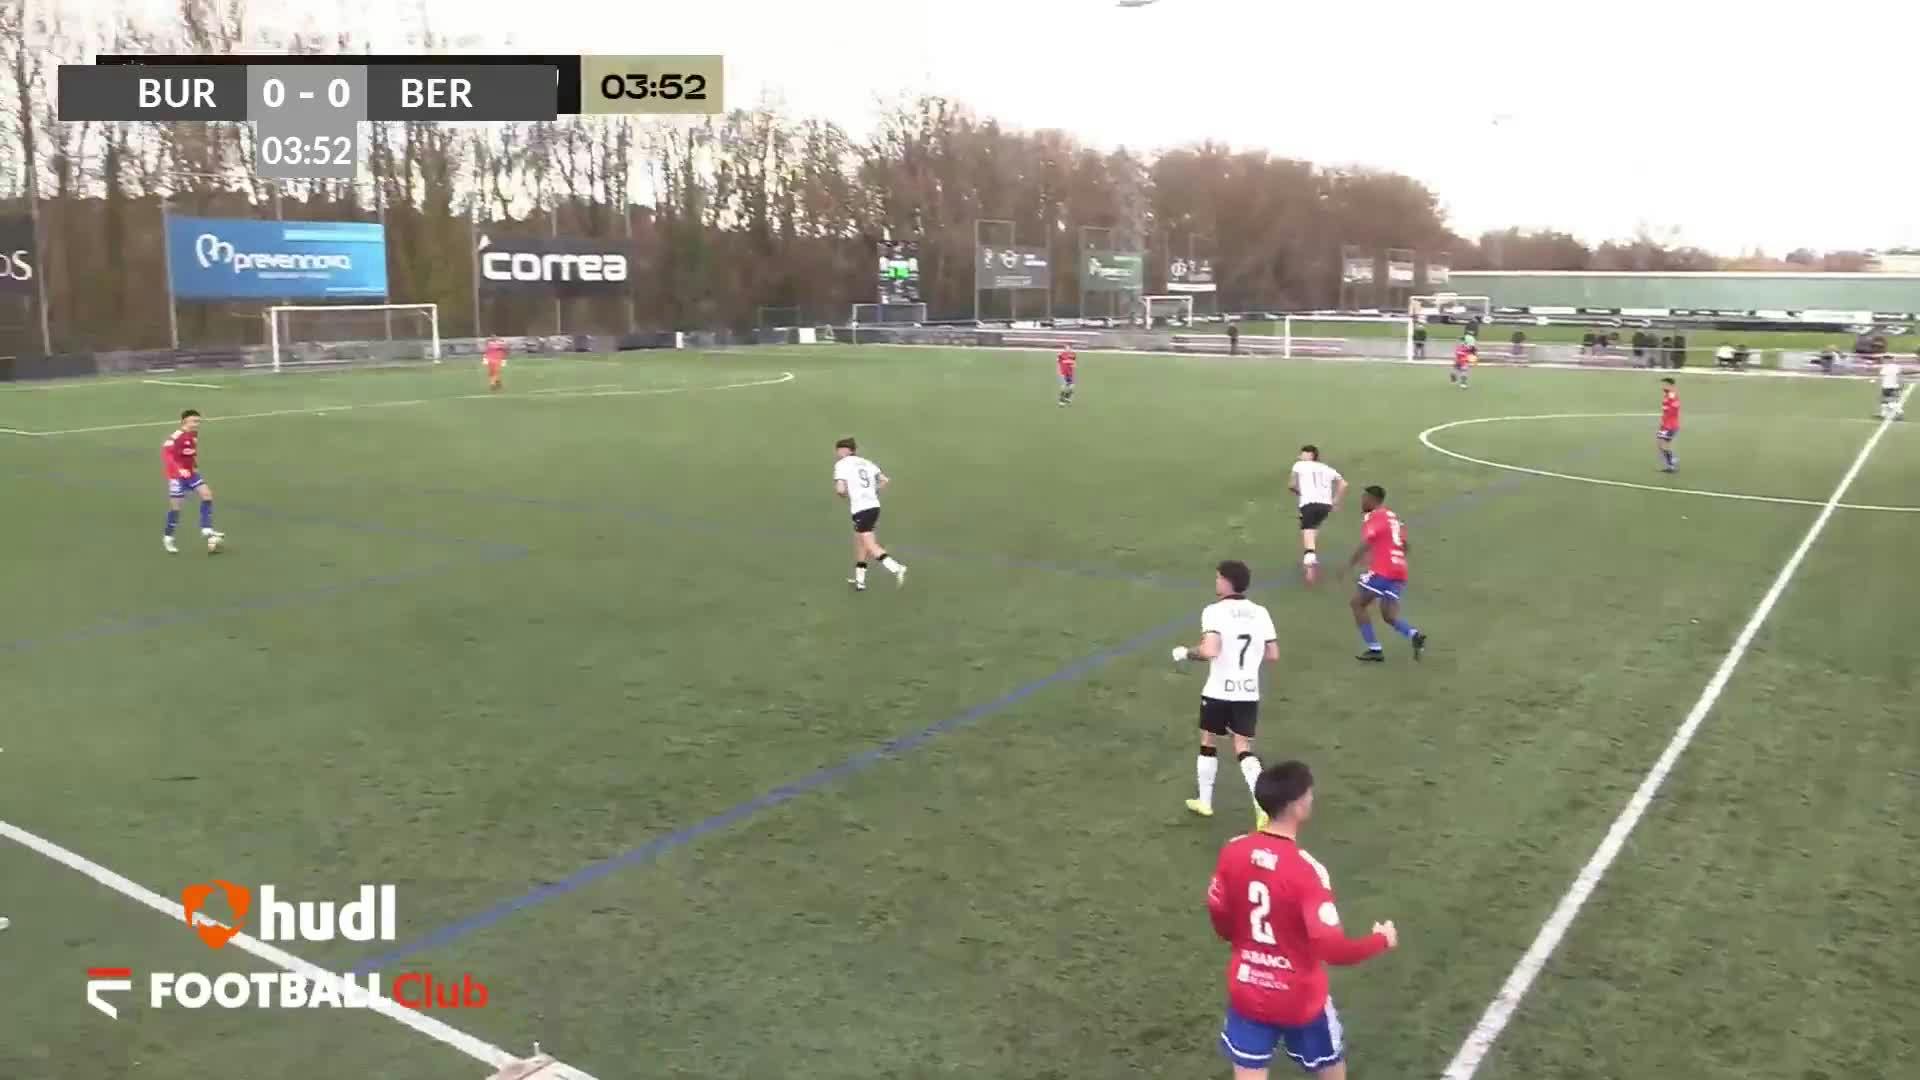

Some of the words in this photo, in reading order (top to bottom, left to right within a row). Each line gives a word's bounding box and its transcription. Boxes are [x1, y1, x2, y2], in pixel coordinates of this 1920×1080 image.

[482, 251, 628, 282] correa
[1237, 633, 1252, 670] 7
[1248, 880, 1276, 945] 2
